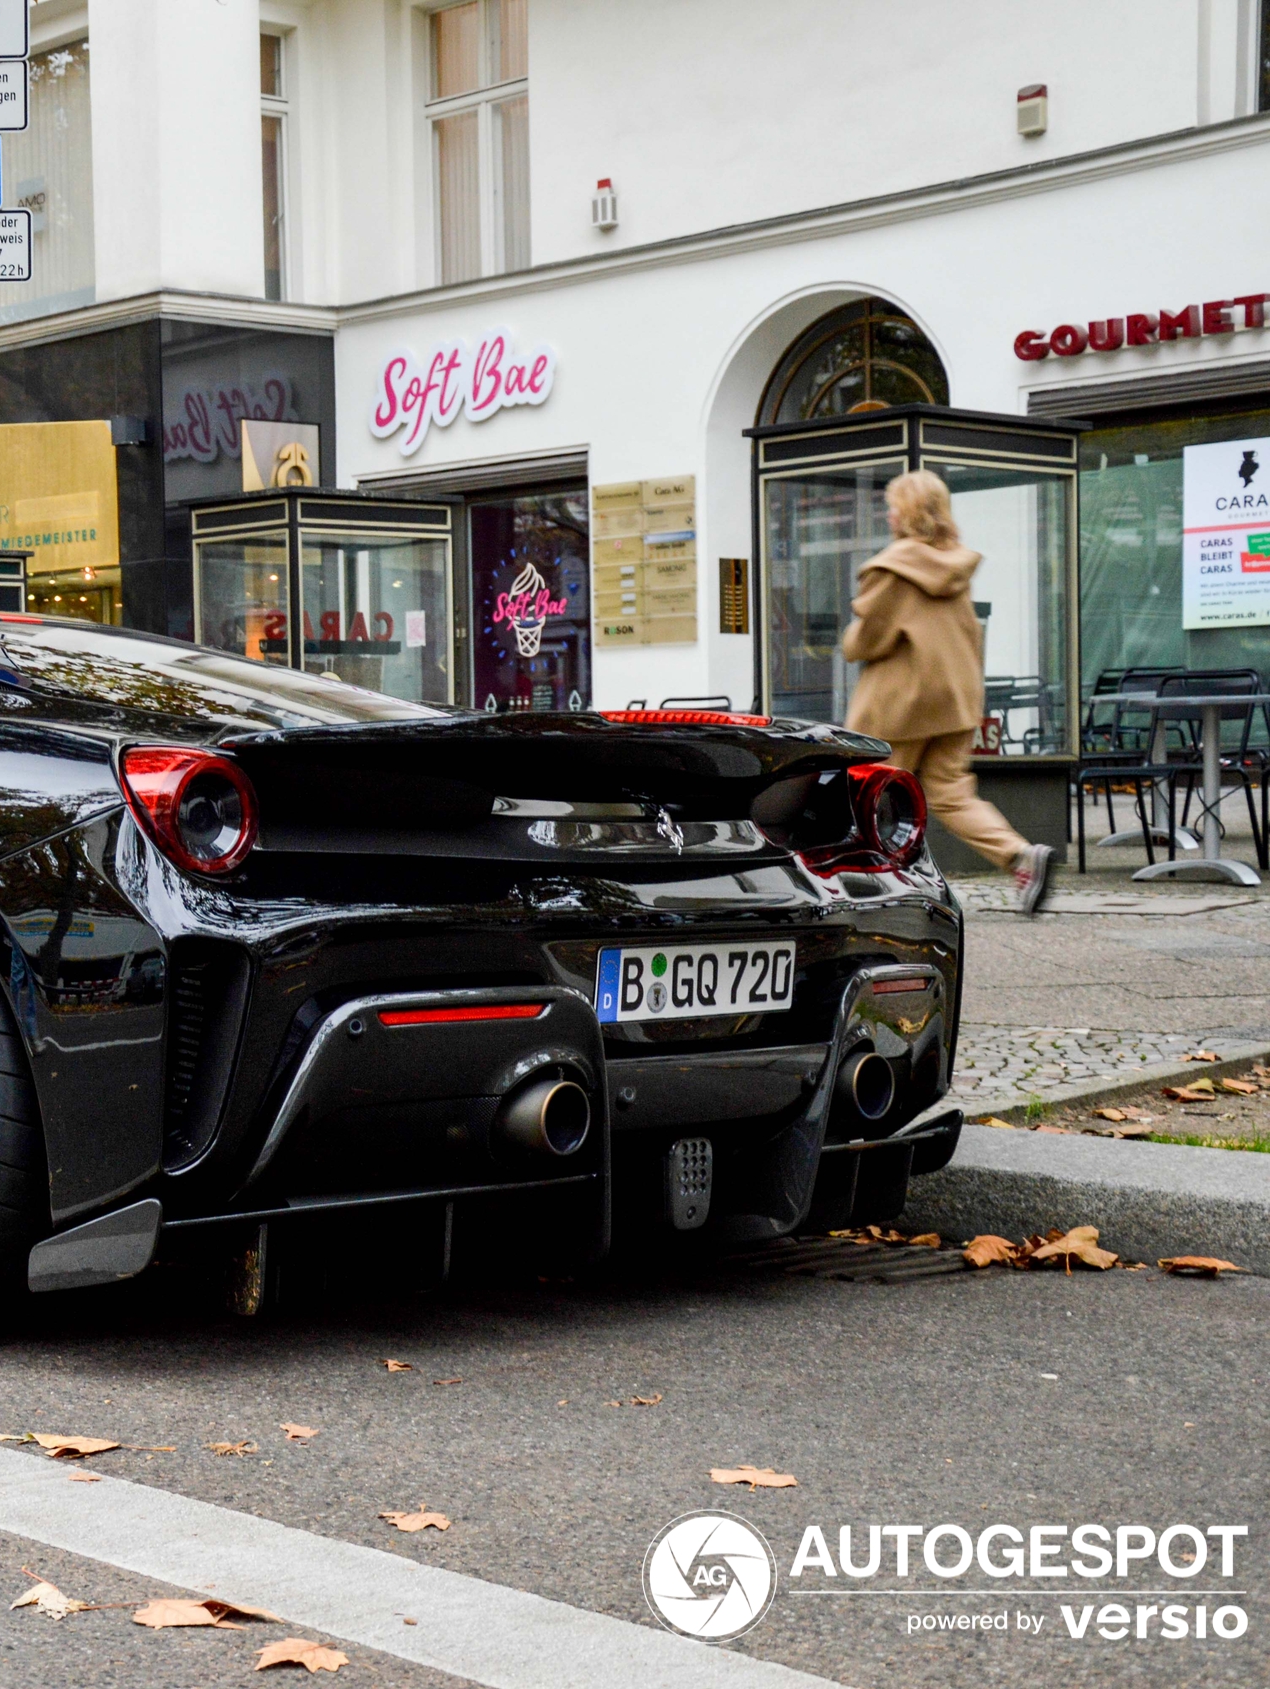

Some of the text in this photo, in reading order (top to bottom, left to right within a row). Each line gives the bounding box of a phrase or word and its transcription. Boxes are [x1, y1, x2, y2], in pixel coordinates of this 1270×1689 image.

[1014, 293, 1270, 361] GOURMET
[375, 335, 549, 446] Soft Bae
[1200, 537, 1233, 548] CARAS
[1200, 551, 1233, 562] BLEIBT
[1200, 564, 1233, 575] CARAS
[493, 588, 568, 631] Soft Bae
[621, 949, 792, 1012] B GQ 720
[603, 993, 613, 1009] D
